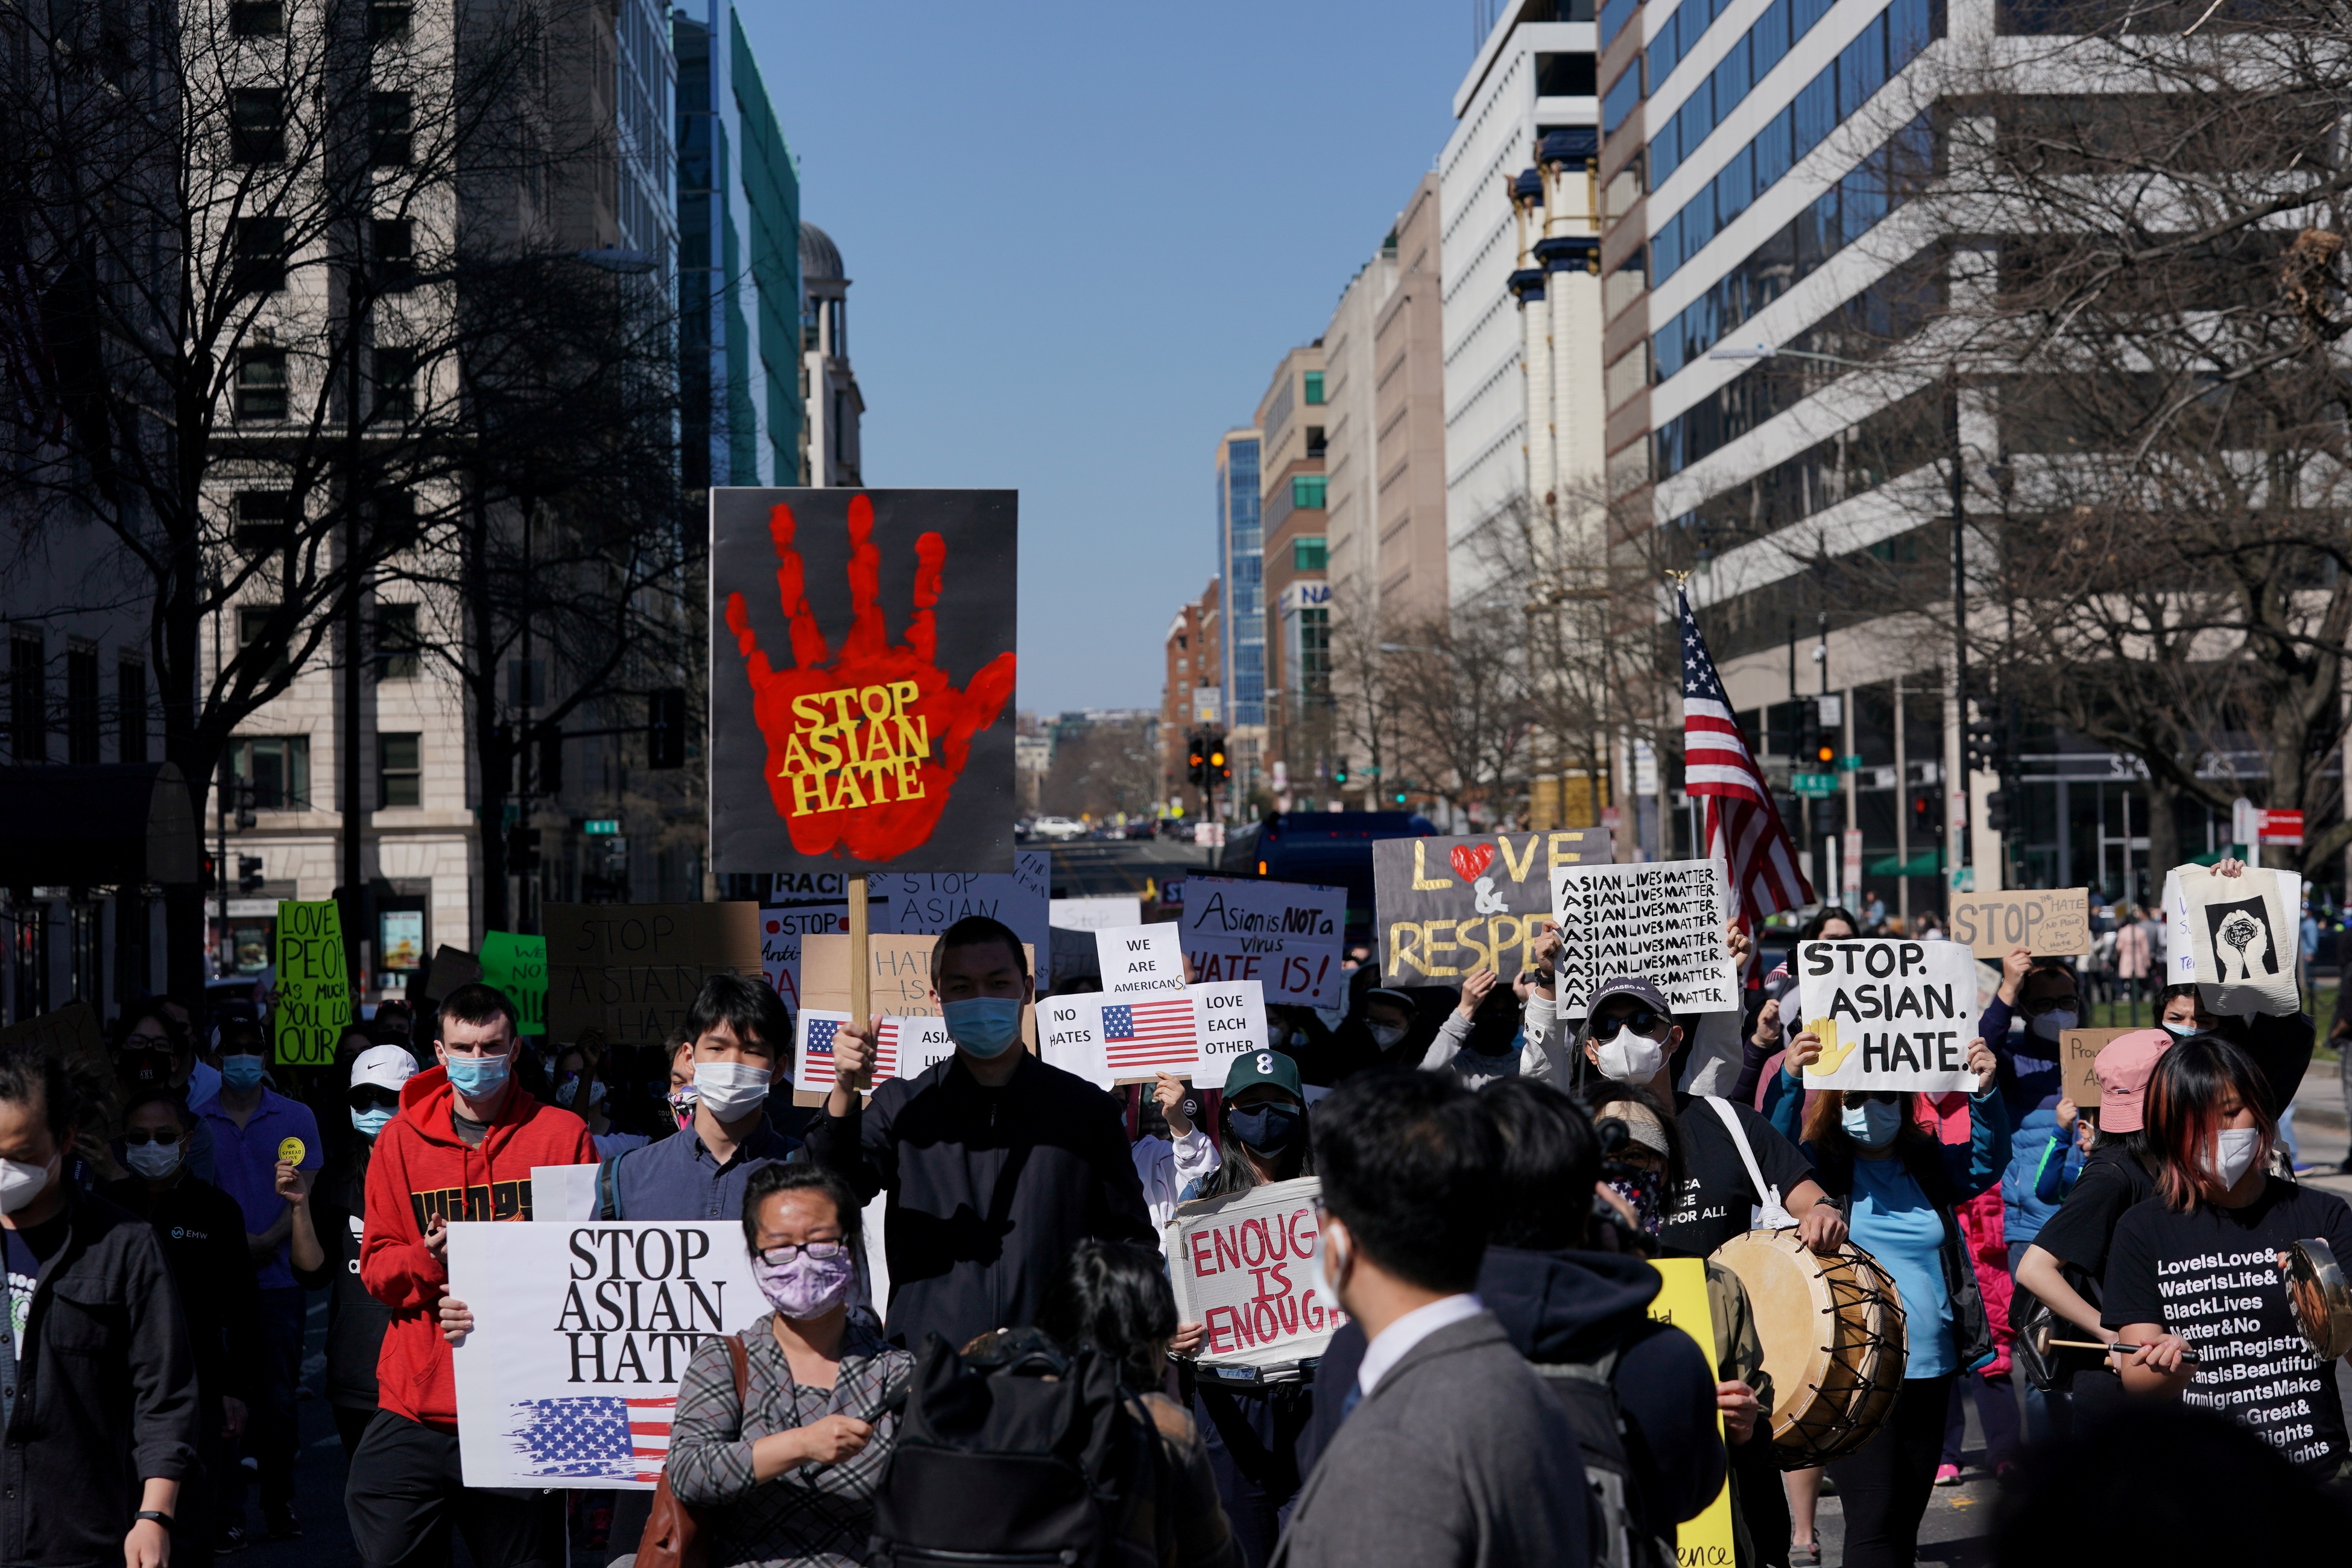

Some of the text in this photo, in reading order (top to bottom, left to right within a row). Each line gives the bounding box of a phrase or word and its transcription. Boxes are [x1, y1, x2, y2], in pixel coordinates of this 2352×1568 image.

[792, 680, 919, 733] STOP
[777, 715, 930, 777] ASIAN
[792, 756, 926, 817] HATE
[1474, 876, 1509, 914] &
[1562, 875, 1621, 894] ASIAN
[901, 899, 997, 923] ASIAN
[1564, 891, 1625, 910] ASIAN
[282, 904, 335, 937] LOVE
[783, 913, 836, 935] STOP
[1193, 892, 1333, 935] Asian is NOT a
[1564, 907, 1626, 928] ASIAN
[1955, 894, 2085, 946] STOP THE HATE
[577, 915, 674, 955] STOP
[1126, 939, 1151, 951] WE
[1241, 936, 1283, 953] virus
[1564, 925, 1626, 944] ASIAN
[762, 940, 801, 961] Anti-
[1563, 941, 1627, 962] ASIAN
[1804, 943, 1926, 978] STOP.
[1128, 960, 1156, 973] ARE
[1190, 951, 1261, 981] HATE
[1564, 960, 1628, 978] ASIAN
[282, 981, 345, 1001] AS MUCH
[570, 965, 704, 1004] ASIAN
[900, 979, 925, 1001] IS
[1114, 975, 1184, 993] AMERICANS
[1206, 995, 1244, 1009] LOVE
[1829, 984, 1966, 1022] ASIAN.
[283, 1001, 323, 1028] YOU
[1054, 1008, 1076, 1022] NO
[1208, 1017, 1247, 1032] EACH
[279, 1026, 334, 1063] OUR
[1049, 1030, 1091, 1047] HATES
[1205, 1040, 1254, 1054] OTHER
[1256, 1052, 1273, 1074] 8
[1864, 1031, 1968, 1072] HATE.
[74, 1160, 83, 1180] smart
[1669, 1210, 1697, 1225] FOR
[1701, 1206, 1727, 1219] ALL
[186, 1230, 208, 1240] EMW
[1190, 1208, 1326, 1277] ENOUG
[569, 1228, 710, 1281] STOP
[2157, 1247, 2277, 1276] LoveIsLove&
[1248, 1262, 1292, 1303] IS
[2158, 1269, 2278, 1298] WaterIsLife&
[554, 1280, 726, 1332] ASIAN
[2163, 1295, 2263, 1320] BlackLives
[2193, 1335, 2308, 1362] slimRegistry
[2183, 1377, 2321, 1411] ImmigrantsMake
